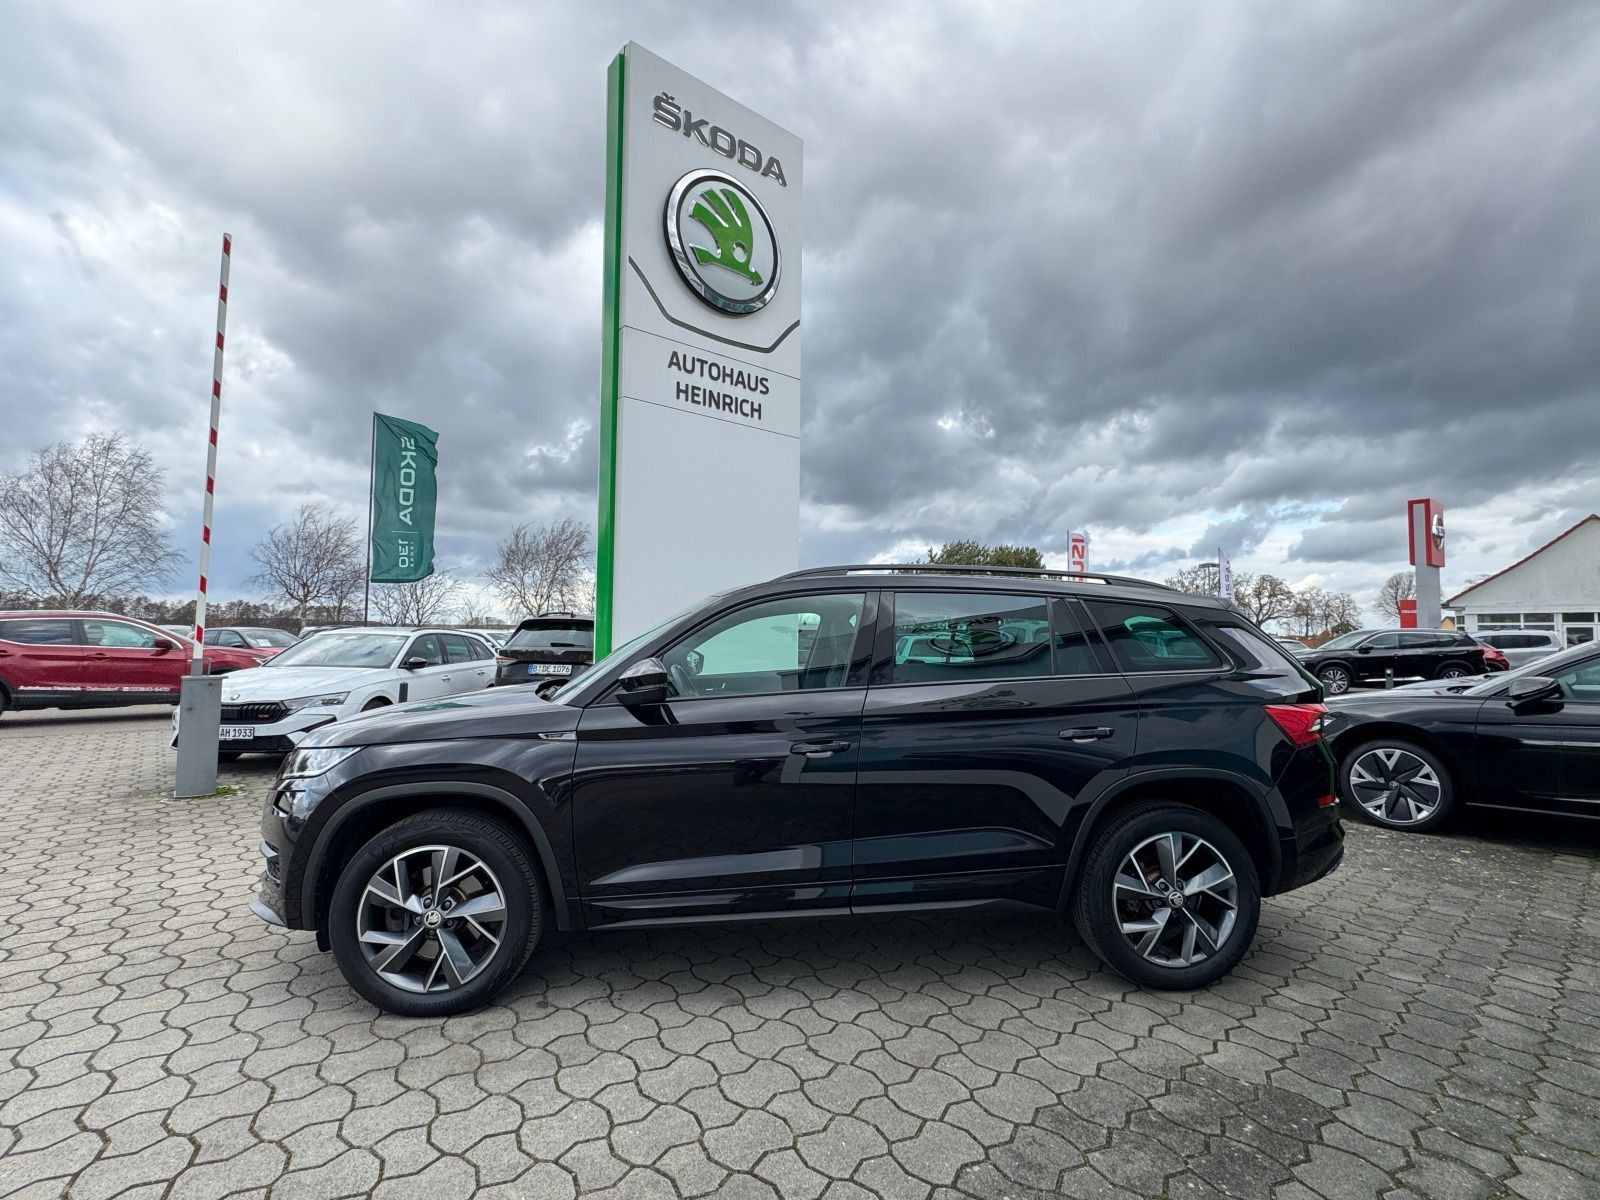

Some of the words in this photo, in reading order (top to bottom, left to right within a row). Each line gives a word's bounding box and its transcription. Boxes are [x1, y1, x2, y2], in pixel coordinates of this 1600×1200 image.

[653, 92, 787, 188] ŠKODA
[667, 350, 770, 396] AUTOHAUS
[675, 380, 763, 420] HEINRICH
[552, 665, 570, 673] 1076
[220, 728, 231, 738] AH
[232, 728, 253, 738] 1933
